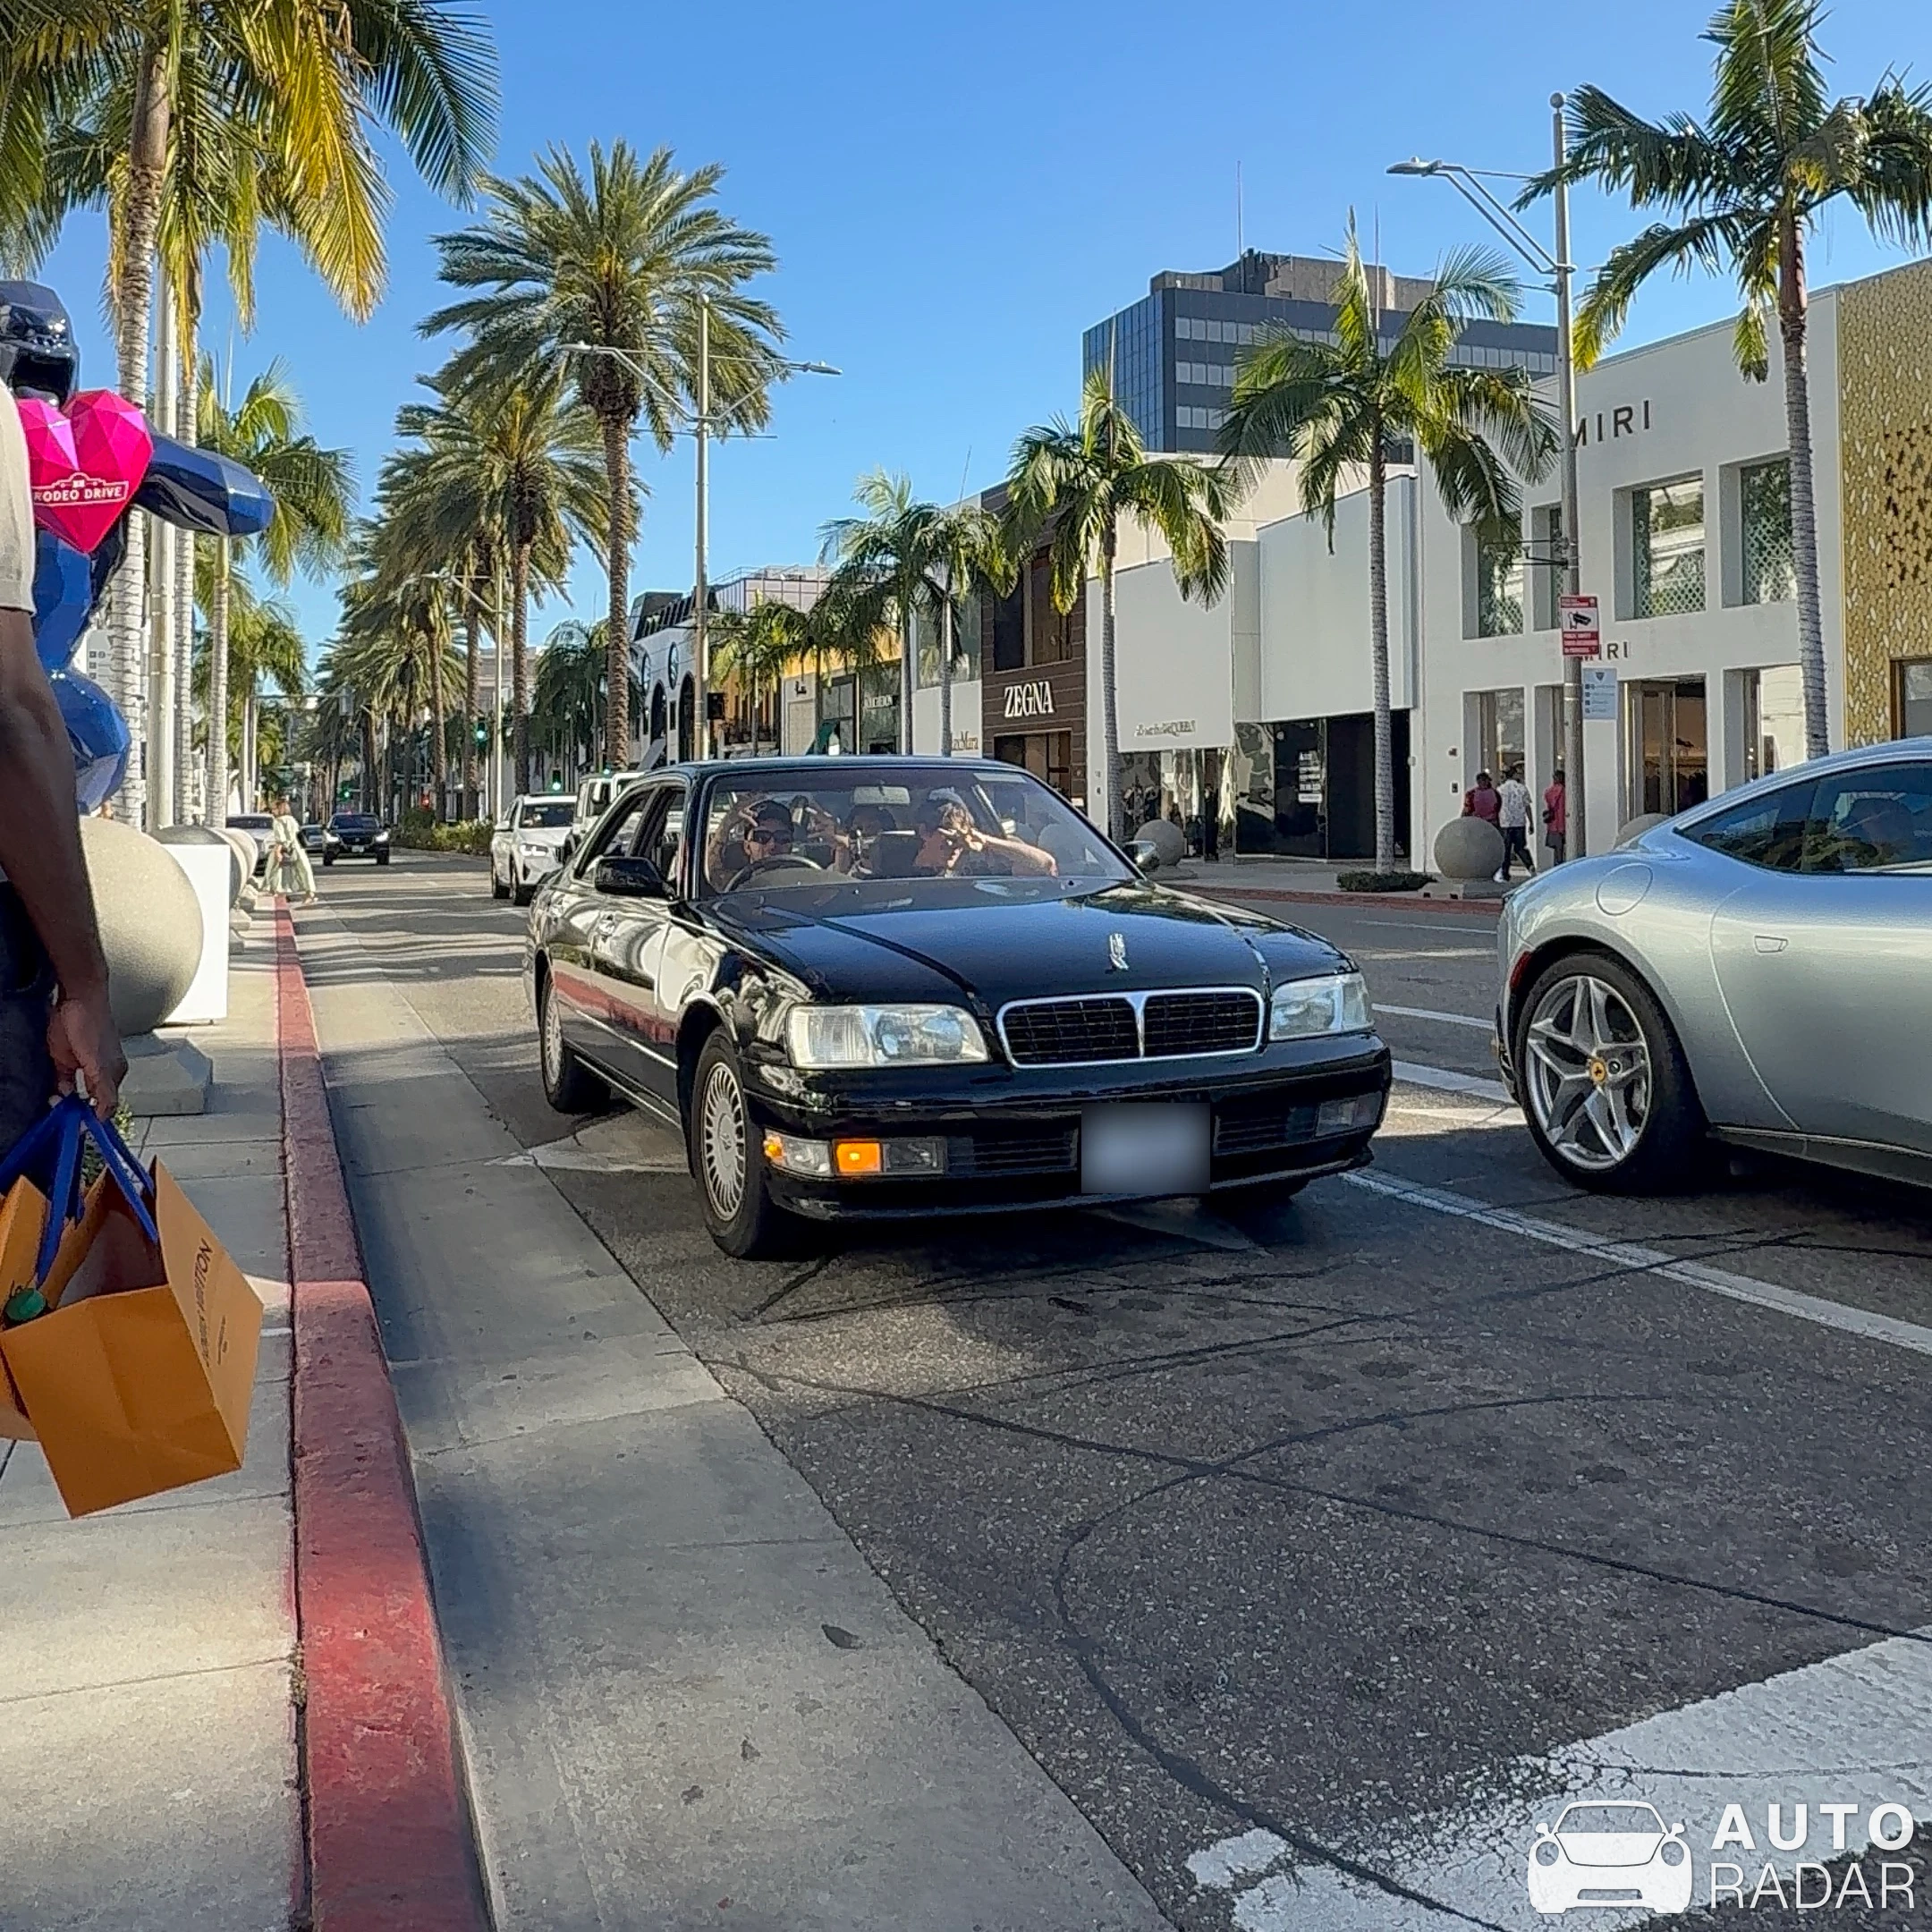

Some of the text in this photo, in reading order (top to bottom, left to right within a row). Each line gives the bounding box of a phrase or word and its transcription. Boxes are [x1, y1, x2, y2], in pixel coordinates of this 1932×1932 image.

[34, 486, 122, 503] RODEO DRIVE
[1004, 681, 1055, 717] ZEGNA
